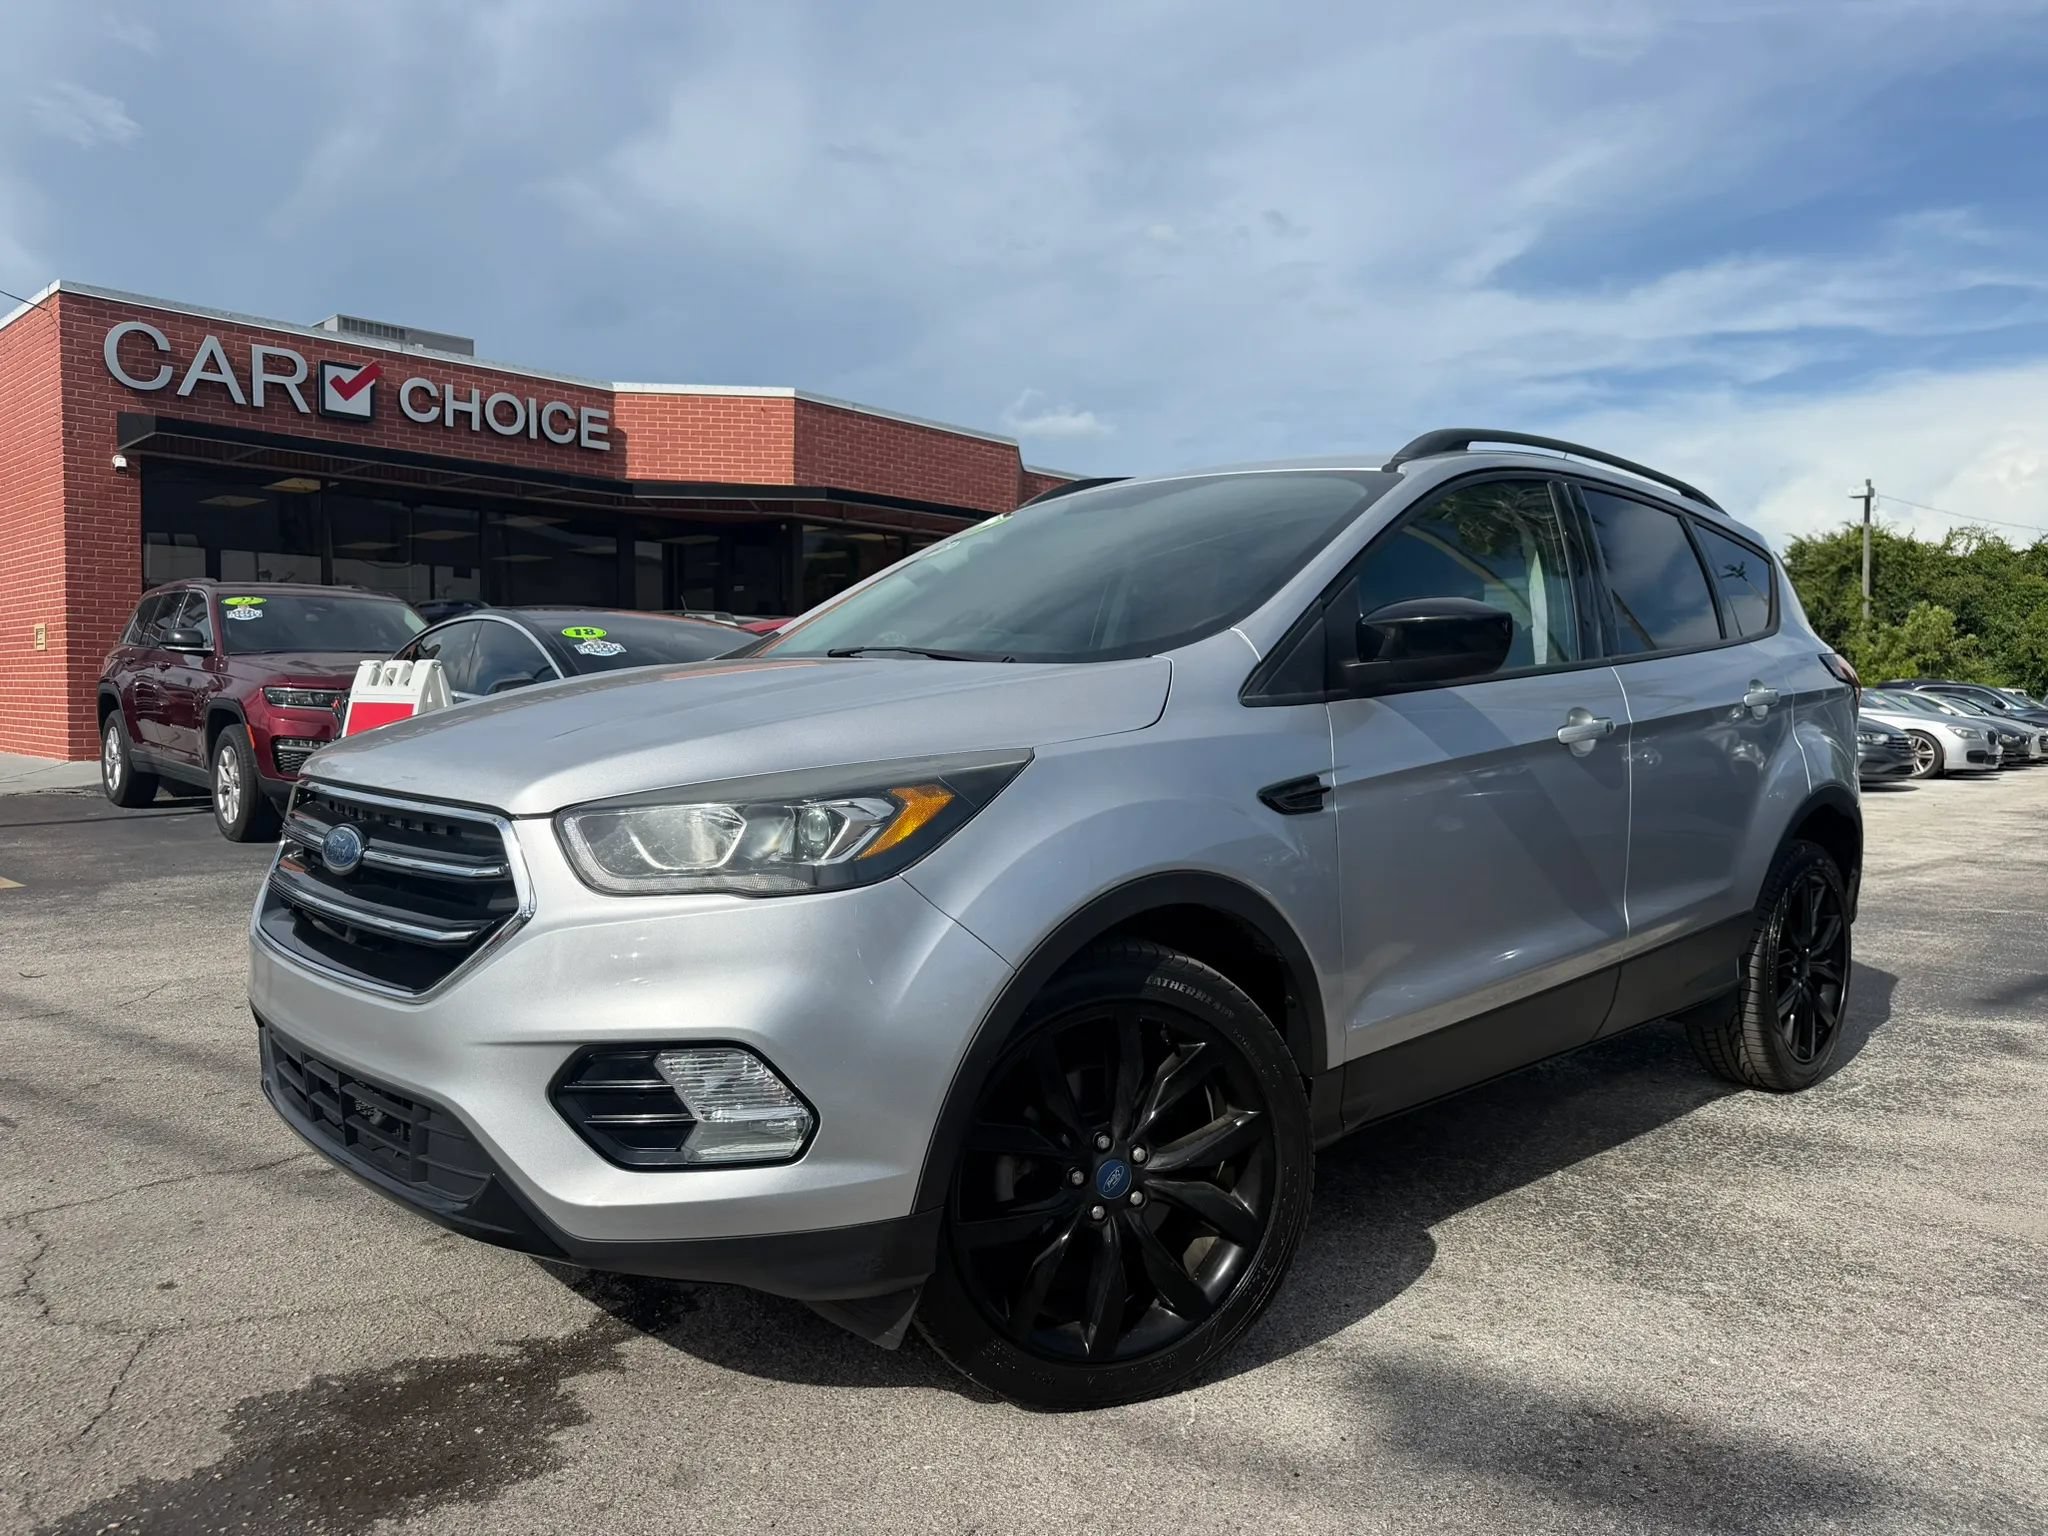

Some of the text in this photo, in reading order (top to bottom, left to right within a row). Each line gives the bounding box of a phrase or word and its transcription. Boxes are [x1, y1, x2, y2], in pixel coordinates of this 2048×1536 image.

[103, 321, 611, 451] CAR CHOICE
[1142, 975, 1235, 1019] EATHERREADY
